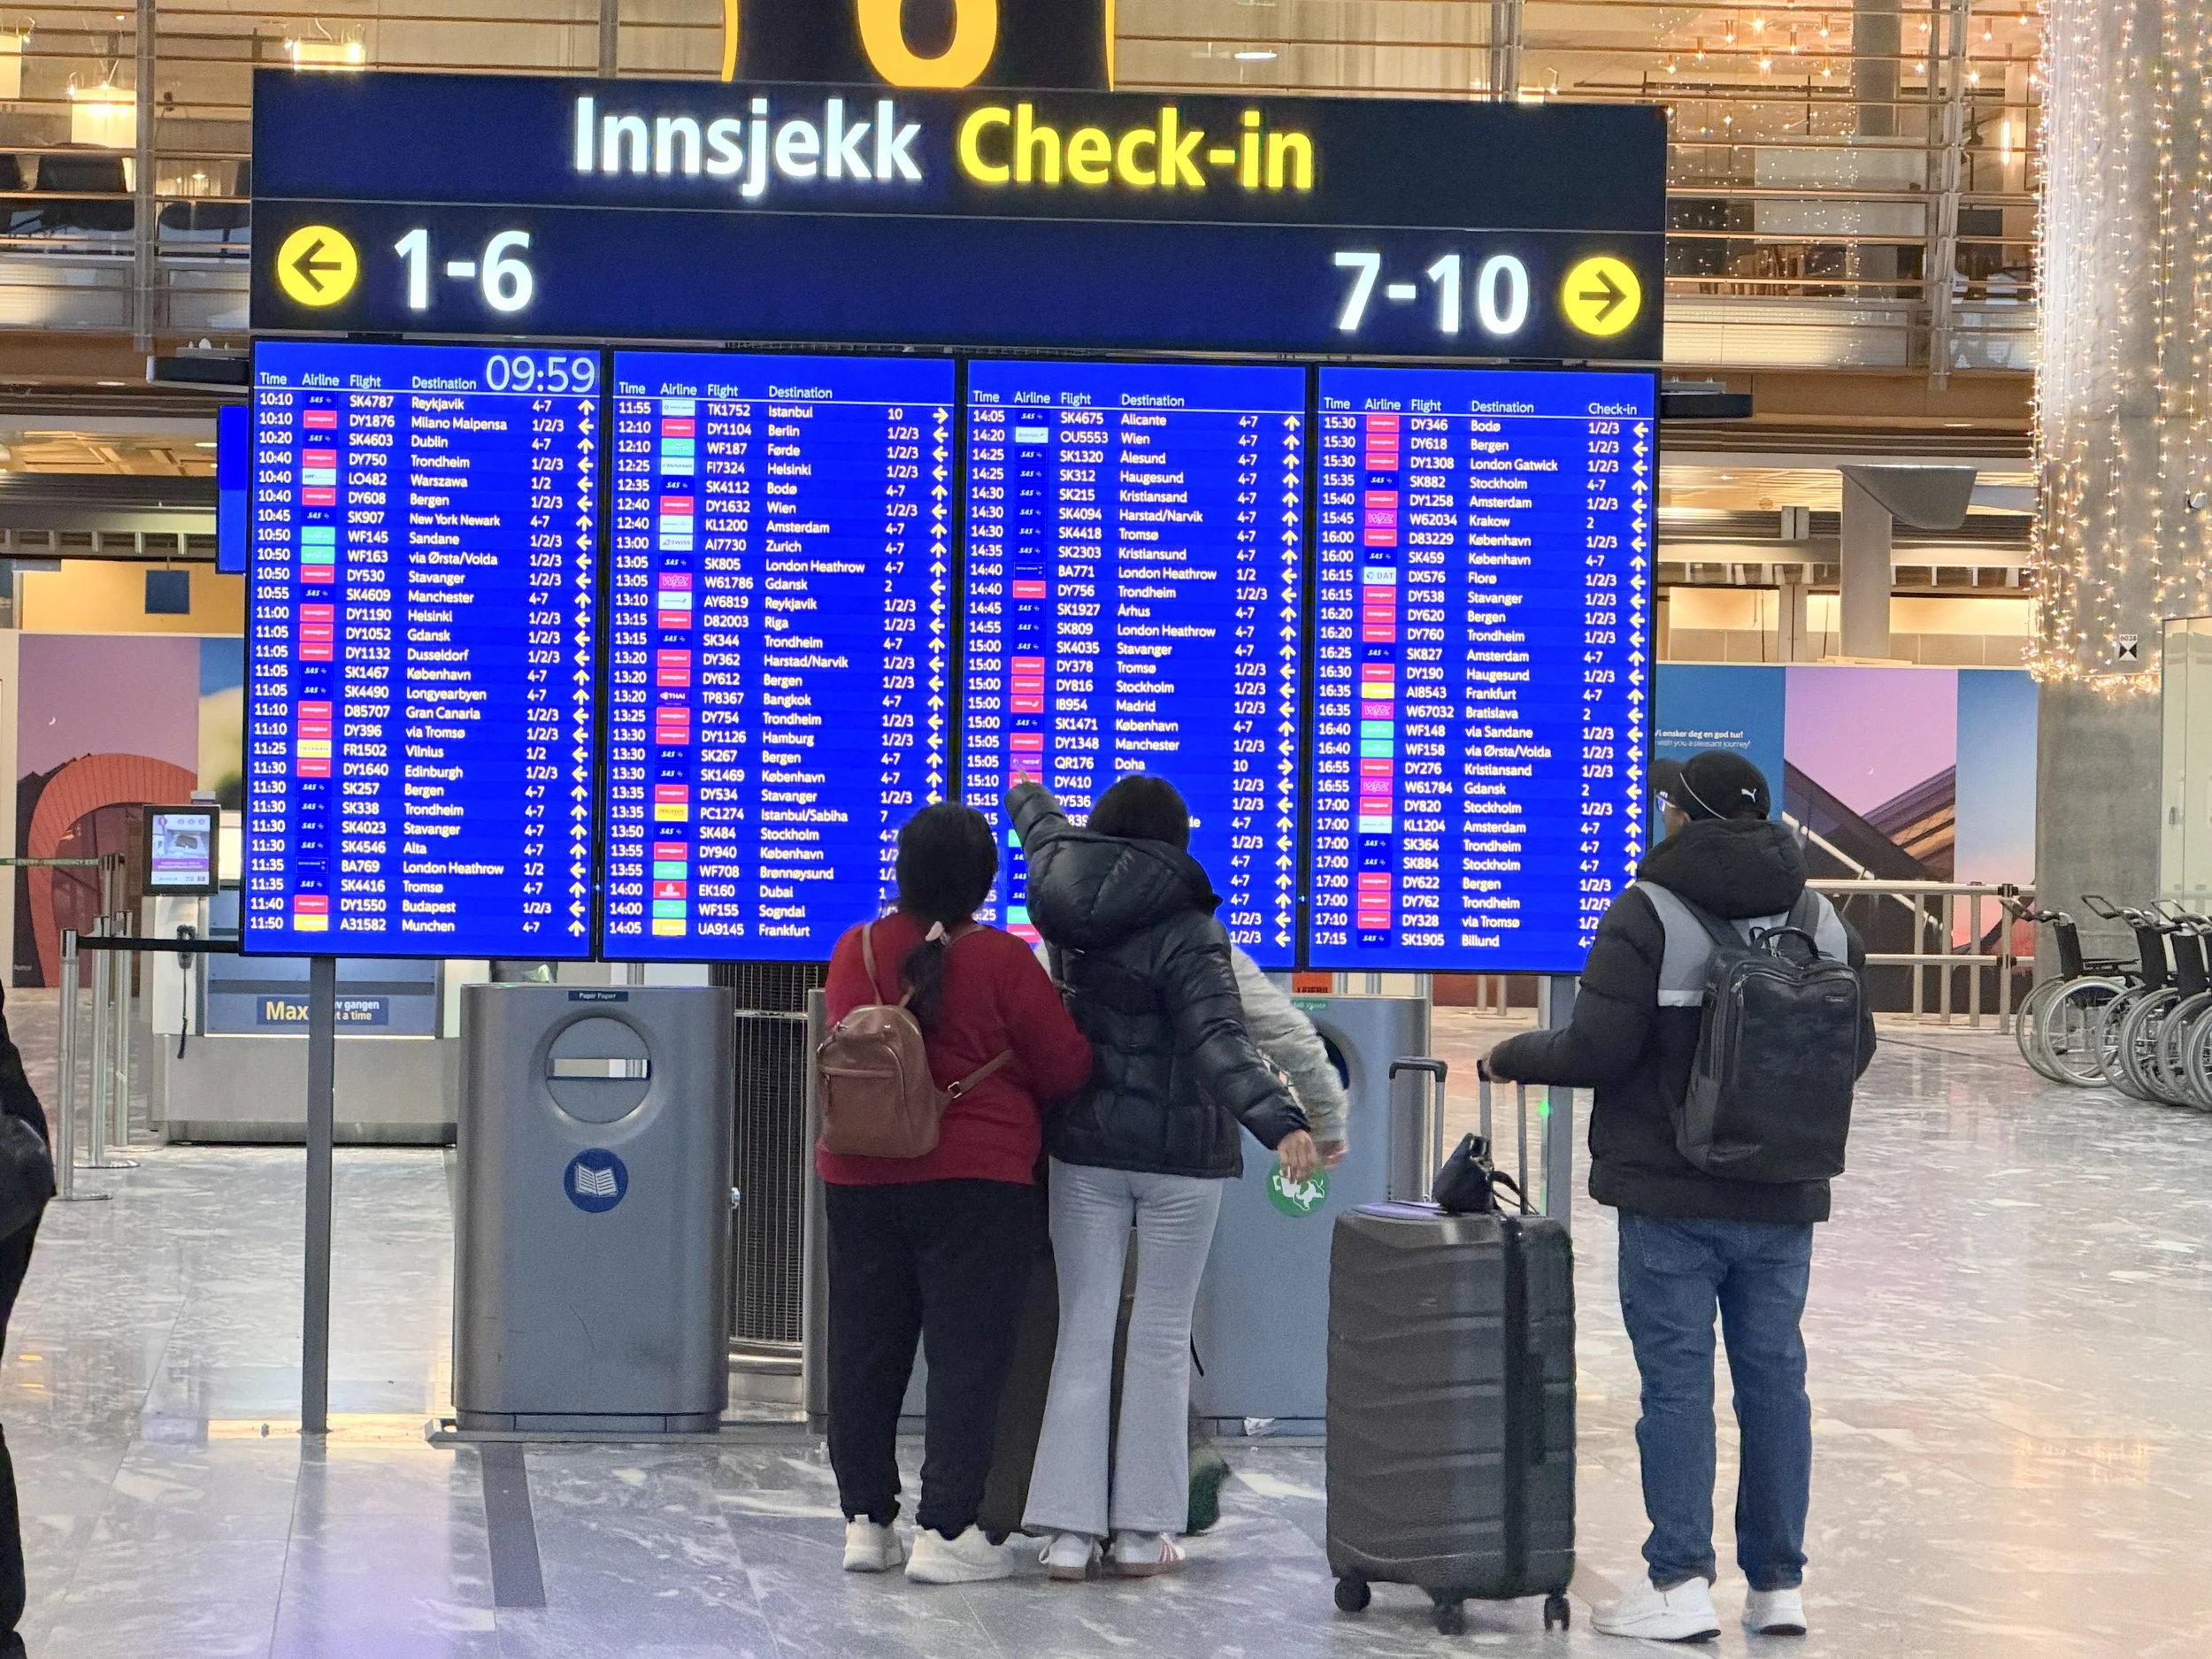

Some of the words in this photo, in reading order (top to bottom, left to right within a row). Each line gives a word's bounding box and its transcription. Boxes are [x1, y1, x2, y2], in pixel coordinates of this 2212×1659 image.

[577, 97, 921, 197] Innsjekk
[957, 103, 1314, 191] Check-in
[395, 229, 533, 312] 1-6
[1335, 252, 1528, 334] 7-10
[260, 372, 287, 385] Time
[302, 373, 339, 386] Airline
[350, 374, 381, 388] Flight
[411, 376, 476, 389] Destination
[485, 355, 595, 393] 09:59
[619, 381, 645, 394] Time
[660, 383, 697, 396] Airline
[707, 384, 738, 398] Flight
[768, 386, 833, 399] Destination
[973, 390, 1000, 403] Time
[1014, 391, 1050, 403] Airline
[1061, 392, 1091, 406] Flight
[1121, 394, 1184, 406] Destination
[259, 393, 293, 405] 10:10
[349, 395, 394, 408] SK4787
[412, 396, 464, 412] Reykjavik
[533, 400, 551, 411] 4-7
[1325, 397, 1350, 409] Time
[1364, 398, 1401, 411] Airline
[1411, 399, 1441, 411] Flight
[1471, 400, 1533, 413] Destination
[1588, 403, 1637, 415] Check-in
[973, 410, 1005, 422] 14:05
[1061, 411, 1103, 425] SK4675
[1121, 413, 1166, 426] Alicante
[1239, 416, 1258, 427] 4-7
[1325, 417, 1356, 429] 15:30
[1411, 419, 1448, 431] DY346
[1471, 419, 1501, 432] Bodø
[1589, 422, 1619, 434] 1/2/3
[618, 420, 651, 434] 12:10
[708, 423, 751, 435] DY1104
[768, 424, 800, 436] Berlin
[888, 426, 918, 440] 1/2/3
[1324, 455, 1356, 467] 15:30
[1410, 457, 1454, 469] DY1308
[1471, 457, 1512, 470] London
[1514, 458, 1558, 471] Gatwick
[1588, 459, 1618, 472] 1/2/3
[972, 467, 1003, 480] 14:25
[1060, 469, 1095, 481] SK312
[1120, 471, 1184, 486] Haugesund
[1238, 472, 1256, 485] 4-7
[618, 479, 649, 491] 12:35
[706, 480, 749, 494] SK4112
[767, 482, 797, 495] Bodø
[887, 485, 905, 496] 4-7
[258, 509, 290, 521] 10:45
[348, 511, 384, 524] SK907
[410, 513, 434, 525] New
[435, 513, 457, 525] York
[460, 514, 500, 526] Newark
[530, 515, 549, 527] 4-7
[972, 544, 1002, 557] 14:35
[1058, 546, 1102, 558] SK2303
[1118, 547, 1187, 560] Kristiansund
[1237, 549, 1256, 561] 4-7
[617, 556, 649, 568] 13:05
[705, 557, 741, 571] SK805
[766, 559, 808, 572] London
[810, 560, 864, 572] Heathrow
[885, 562, 903, 573] 4-7
[1322, 569, 1353, 581] 16:15
[1409, 571, 1446, 583] DX576
[1469, 572, 1497, 584] Florø
[1586, 573, 1617, 587] 1/2/3
[257, 606, 289, 618] 11:00
[347, 608, 391, 621] DY1190
[408, 610, 452, 622] Helsinki
[529, 611, 560, 625] 1/2/3
[970, 621, 1001, 634] 14:55
[1057, 622, 1093, 635] SK809
[1118, 623, 1159, 636] London
[1162, 625, 1216, 637] Heathrow
[1235, 626, 1254, 637] 4-7
[255, 684, 288, 696] 11:05
[345, 685, 389, 698] SK4490
[407, 687, 487, 703] Longyearbyen
[527, 689, 546, 701] 4-7
[969, 678, 1001, 690] 15:00
[1056, 680, 1094, 692] DY816
[1117, 680, 1174, 693] Stockholm
[1235, 682, 1265, 695] 1/2/3
[614, 690, 646, 703] 13:20
[703, 692, 744, 704] TP8367
[764, 693, 811, 708] Bangkok
[882, 695, 902, 707] 4-7
[1319, 722, 1351, 735] 16:40
[1406, 724, 1445, 737] WF148
[1465, 726, 1482, 737] via
[1485, 726, 1533, 738] Sandane
[1583, 726, 1614, 740] 1/2/3
[1688, 730, 1702, 739] deg
[254, 761, 287, 774] 11:30
[343, 763, 388, 776] DY1640
[405, 764, 463, 780] Edinburgh
[526, 765, 557, 780] 1/2/3
[967, 755, 999, 768] 15:05
[1055, 757, 1094, 769] QR176
[1115, 757, 1145, 770] Doha
[1233, 759, 1248, 772] 10
[612, 767, 645, 780] 13:30
[701, 769, 745, 781] SK1469
[762, 770, 825, 783] København
[881, 772, 900, 784] 4-7
[1317, 798, 1349, 811] 17:00
[1404, 800, 1441, 812] DY820
[1463, 800, 1522, 813] Stockholm
[1582, 802, 1613, 816] 1/2/3
[611, 864, 642, 876] 13:55
[699, 865, 740, 878] WF708
[760, 866, 833, 881] Brønnøysund
[250, 917, 283, 929] 11:50
[340, 918, 386, 931] A31582
[402, 919, 455, 932] Munchen
[523, 922, 540, 933] 4-7
[1315, 932, 1347, 945] 17:15
[1402, 933, 1445, 946] SK1905
[1462, 934, 1500, 947] Billund
[266, 1001, 309, 1020] Max
[344, 1001, 379, 1011] gangen
